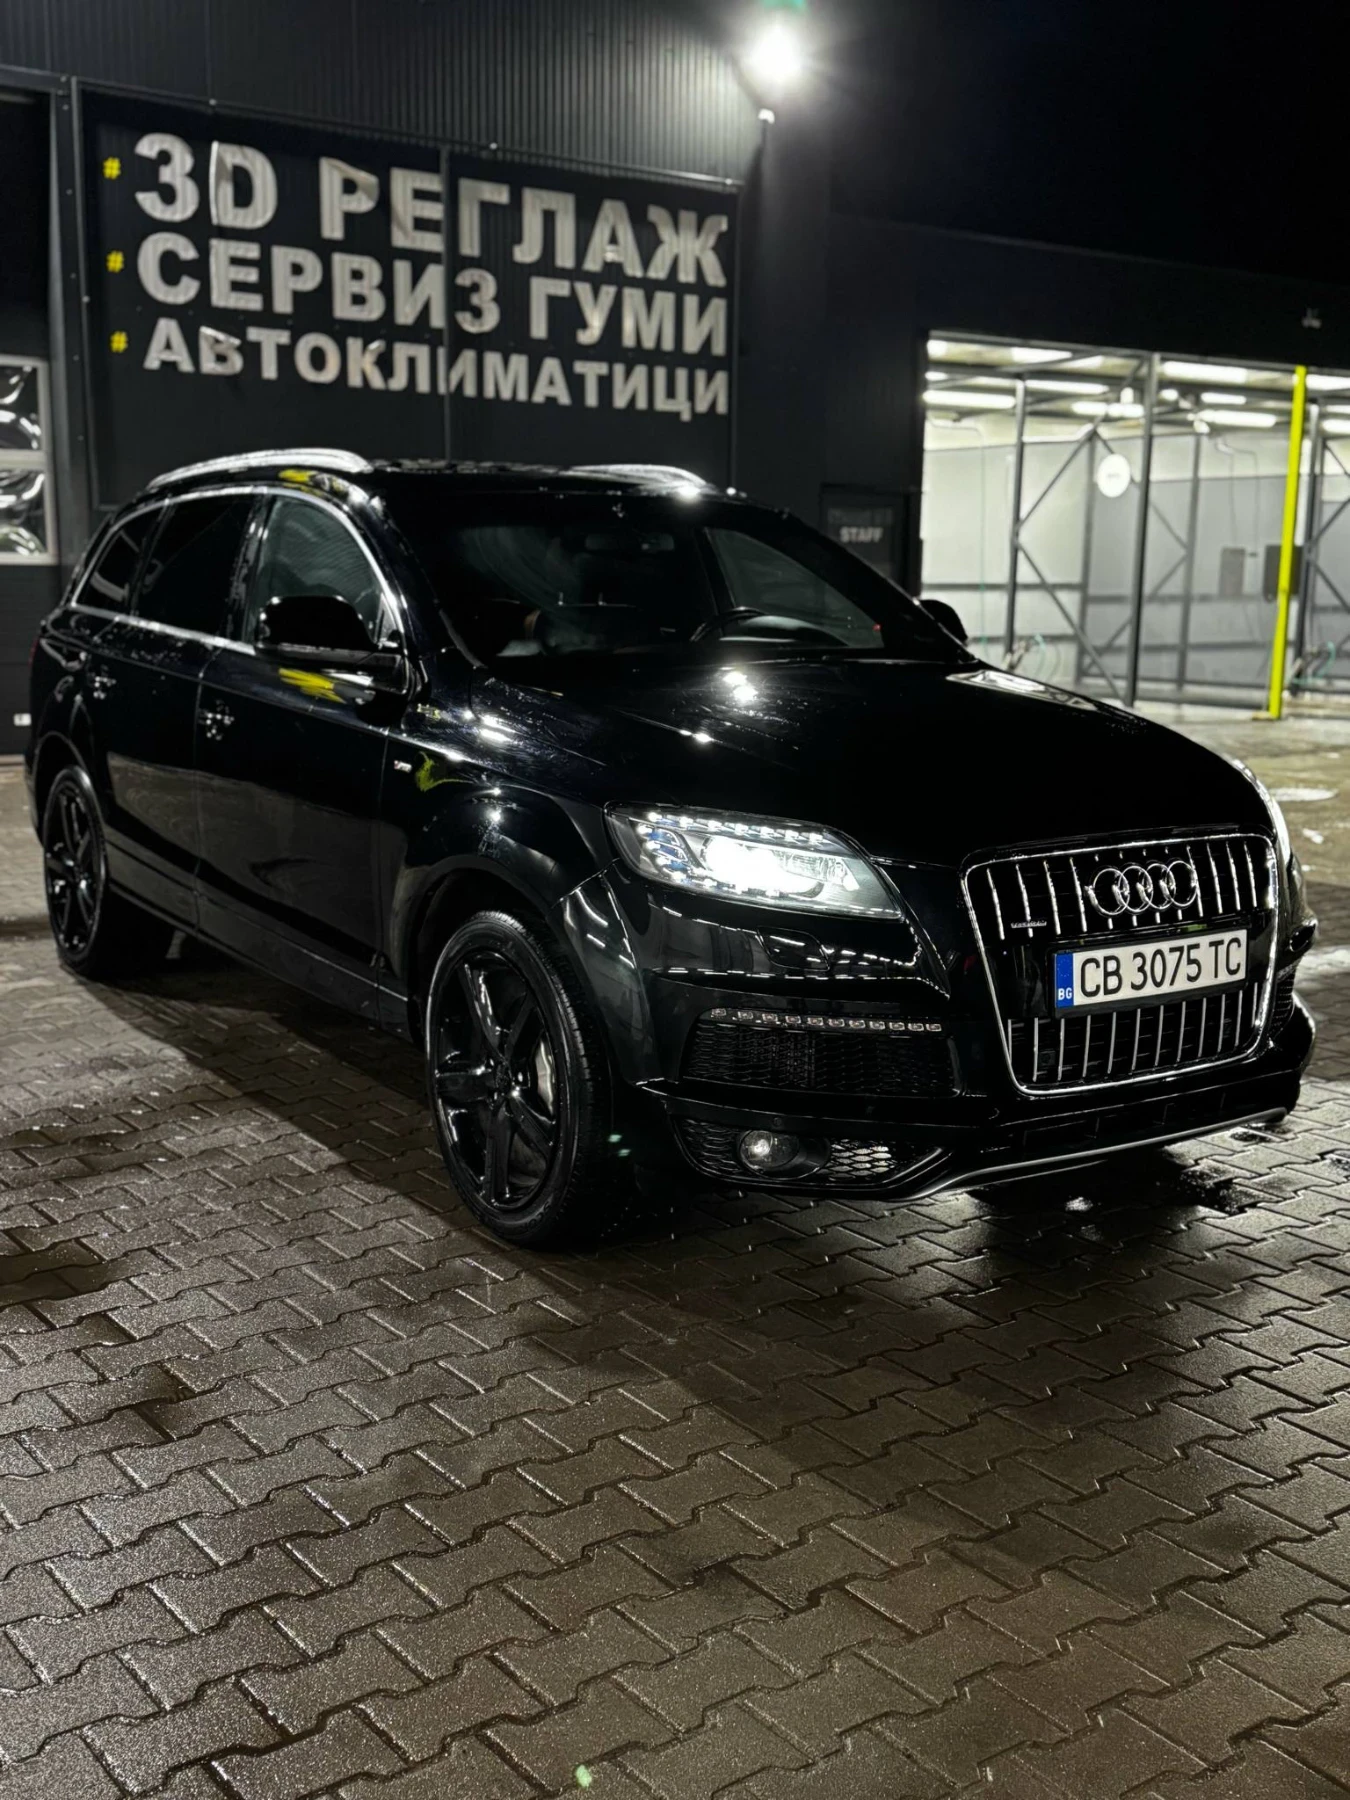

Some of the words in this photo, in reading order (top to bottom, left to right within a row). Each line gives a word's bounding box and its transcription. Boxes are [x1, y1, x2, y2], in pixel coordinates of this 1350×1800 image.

[134, 132, 278, 230] 3D
[319, 156, 729, 288] РЕГЛАЖ
[137, 231, 501, 334] СЕРВИЗ
[528, 275, 727, 356] ГУМИ
[143, 317, 729, 422] АВТОКЛИМАТИЦИ
[1058, 987, 1072, 1000] BG
[1080, 957, 1123, 998] CB
[1130, 943, 1202, 991] 3075
[1209, 937, 1242, 978] TC
